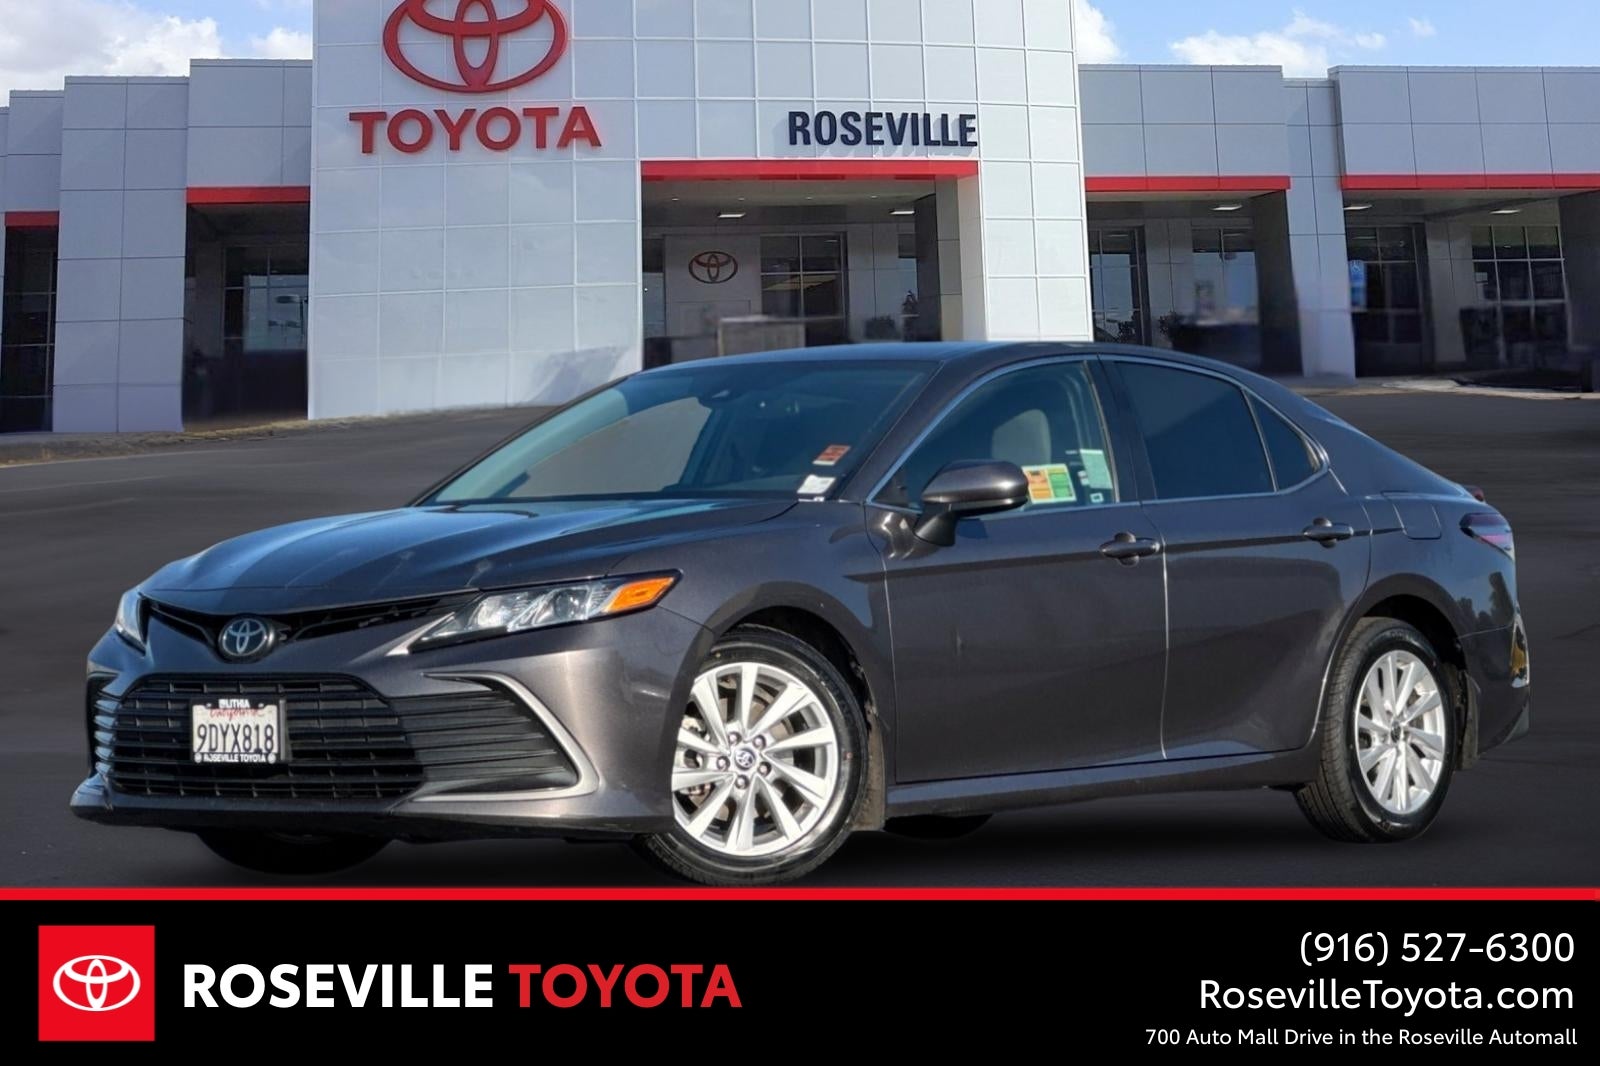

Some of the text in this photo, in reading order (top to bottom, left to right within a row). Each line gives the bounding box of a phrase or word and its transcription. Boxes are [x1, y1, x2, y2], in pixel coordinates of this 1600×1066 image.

[349, 106, 602, 154] TOYOTA
[788, 110, 979, 148] ROSEVILLE
[197, 723, 274, 754] 9DYX818
[203, 754, 266, 762] ROSEVILLE TOYOTA
